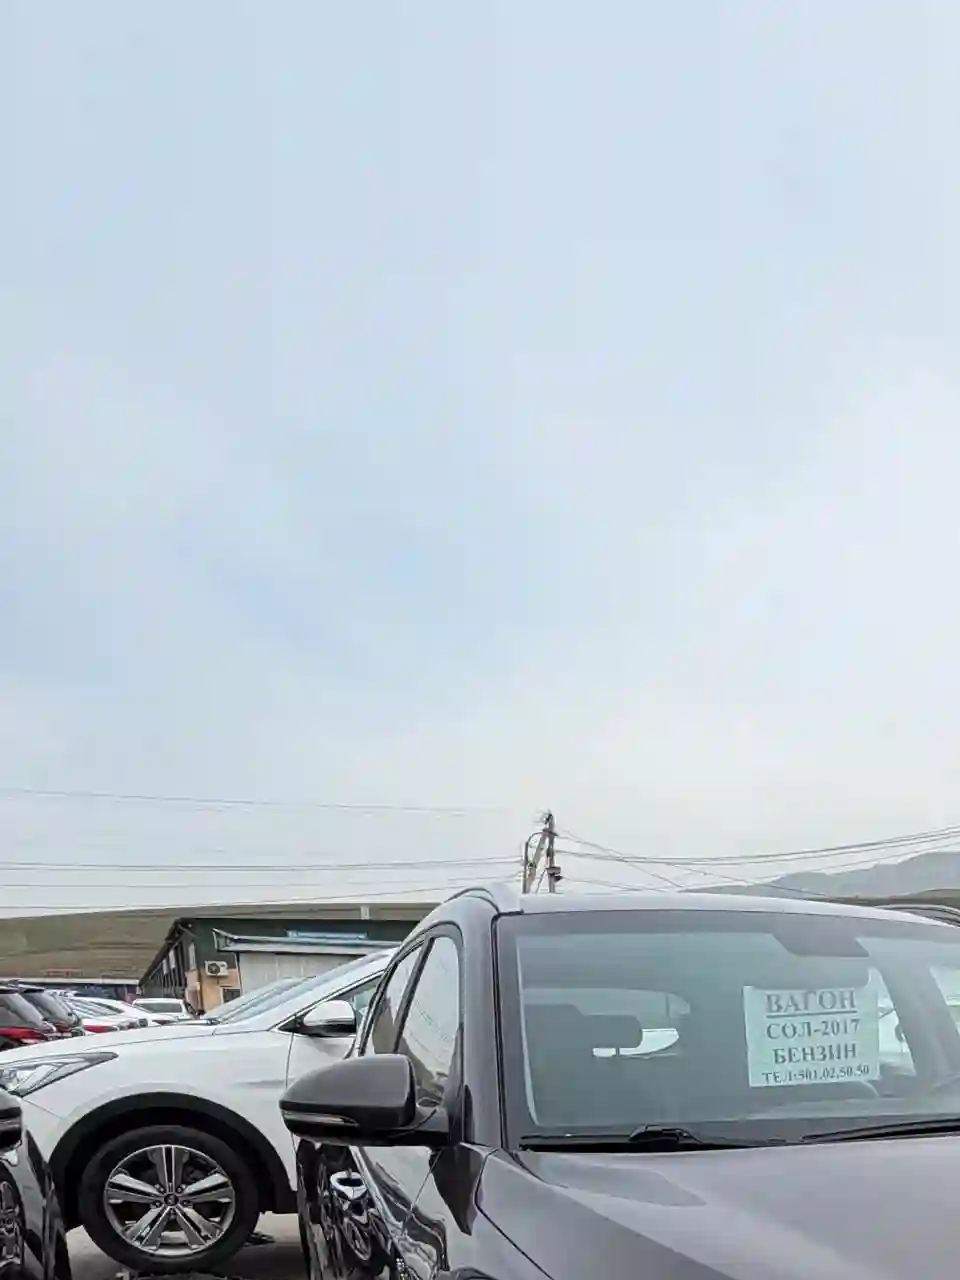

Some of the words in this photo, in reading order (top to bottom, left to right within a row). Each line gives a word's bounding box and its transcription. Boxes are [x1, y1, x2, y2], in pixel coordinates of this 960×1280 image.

[765, 989, 856, 1014] ВАГОН
[766, 1019, 860, 1040] СОЛ-2017
[773, 1043, 857, 1065] БЕНЗИН
